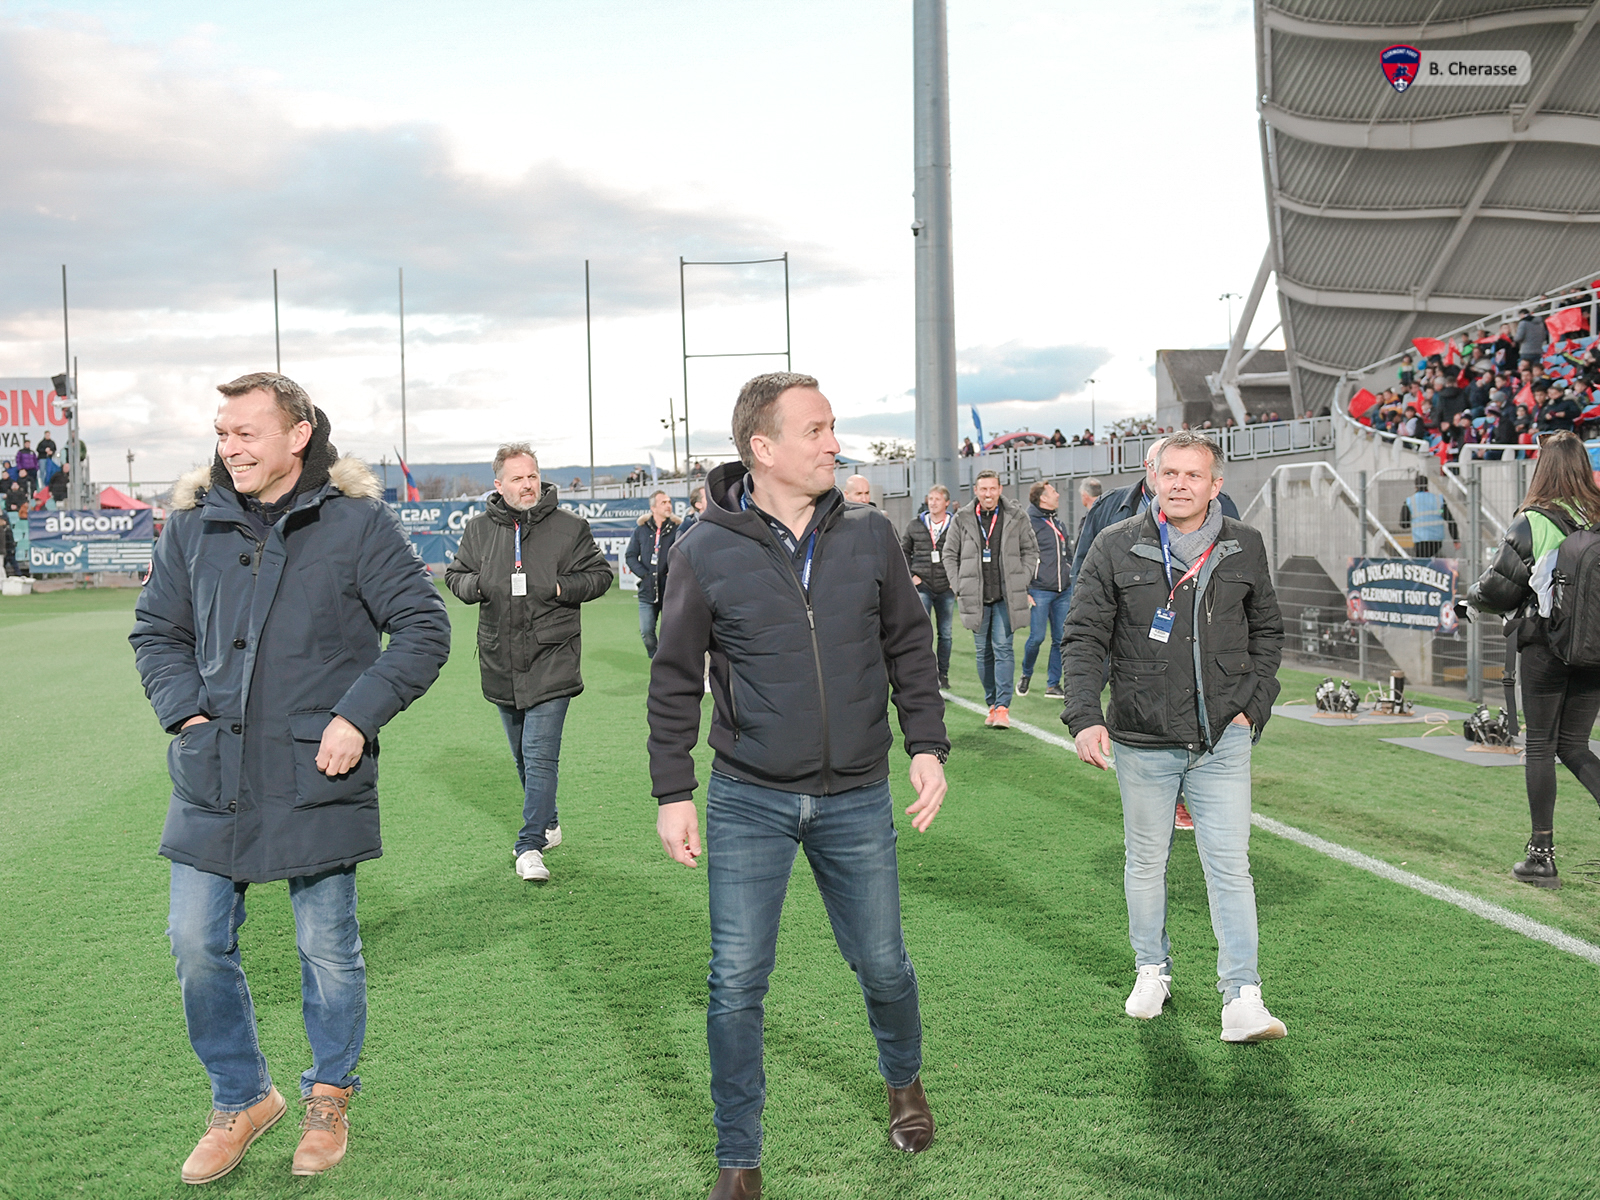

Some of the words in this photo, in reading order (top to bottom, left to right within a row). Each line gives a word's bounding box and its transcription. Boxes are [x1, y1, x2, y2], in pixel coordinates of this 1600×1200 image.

[0, 432, 28, 447] YAT
[45, 510, 135, 532] abicom
[401, 508, 441, 521] C2AP
[1352, 568, 1366, 586] UN
[1367, 563, 1403, 582] VOLCAN
[1360, 587, 1403, 604] CLERMONT
[1405, 590, 1426, 606] FOOT
[1428, 591, 1442, 607] 63
[1363, 609, 1389, 623] AMICALE
[1389, 611, 1401, 624] DES
[1401, 612, 1439, 628] SUPPORTERS
